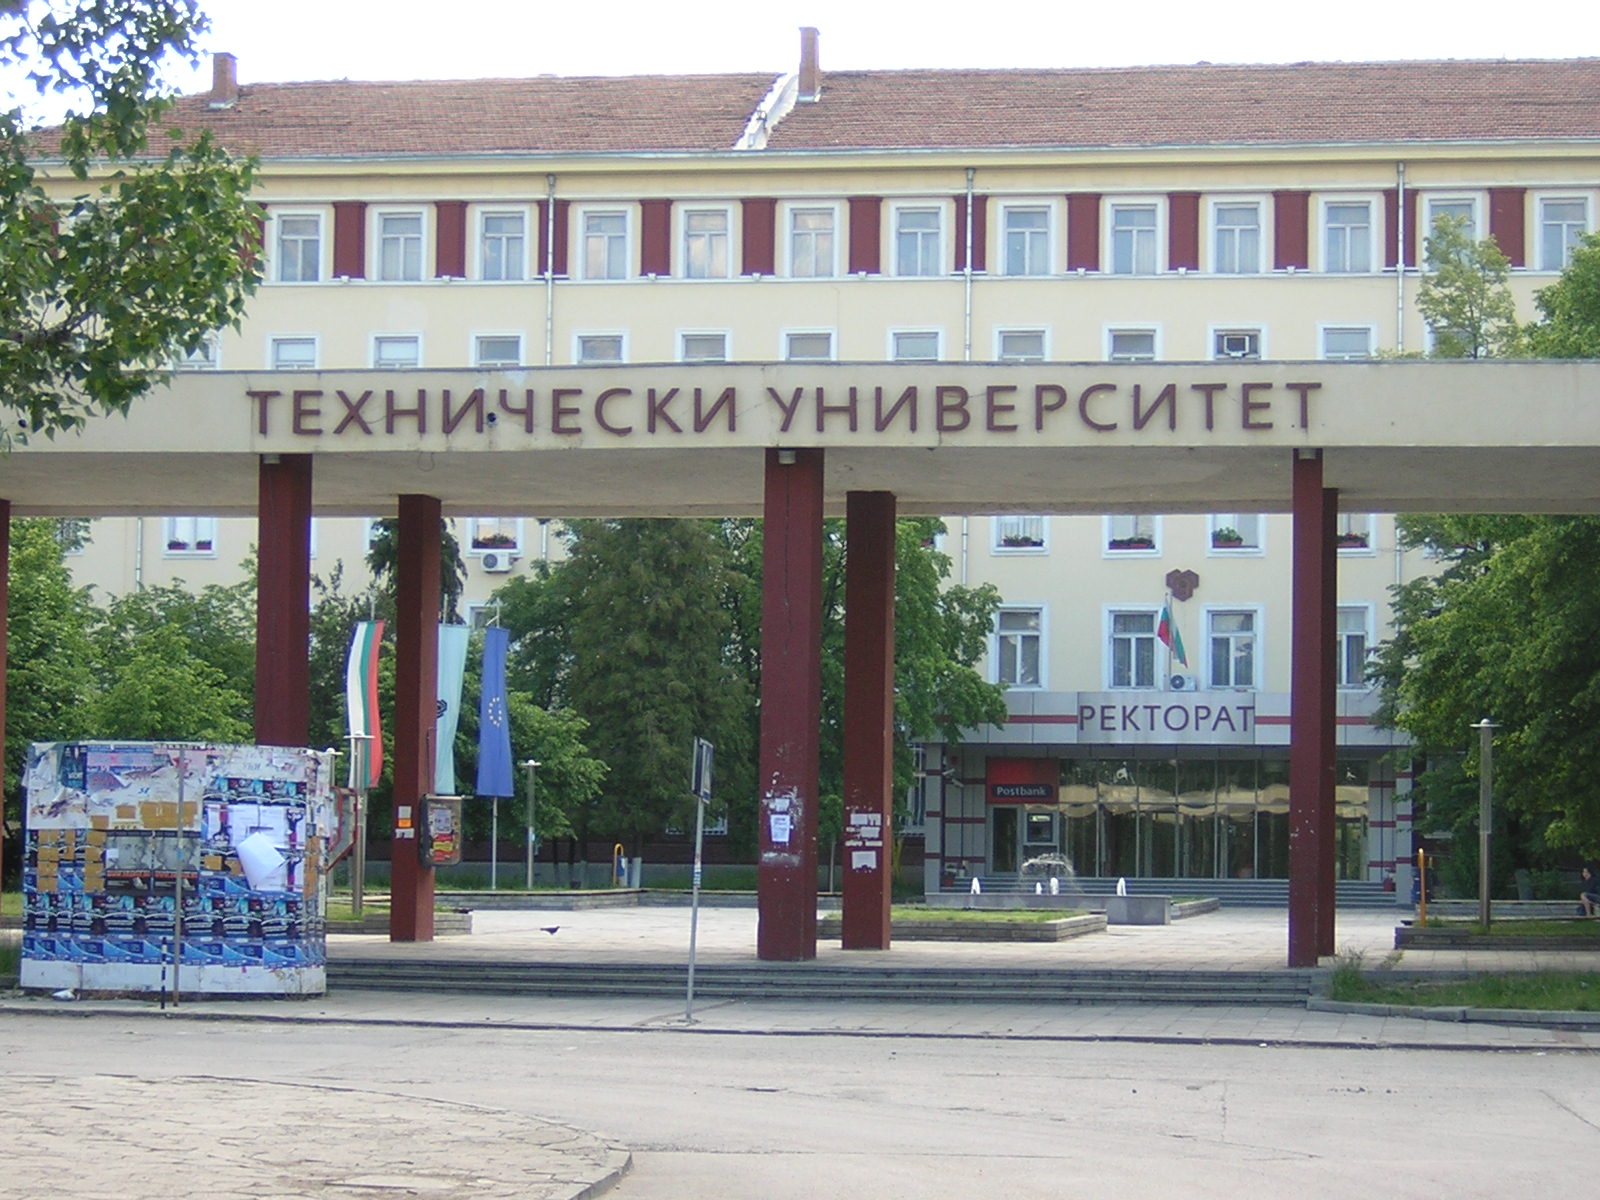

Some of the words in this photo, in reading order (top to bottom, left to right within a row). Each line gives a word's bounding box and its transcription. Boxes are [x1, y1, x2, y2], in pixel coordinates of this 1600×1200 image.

[246, 387, 737, 435] ТЕХНИЧЕСКИ
[766, 382, 1322, 433] УНИВЕРСИТЕТ
[1079, 705, 1255, 732] РЕКТОРАТ
[996, 786, 1047, 796] Postbank
